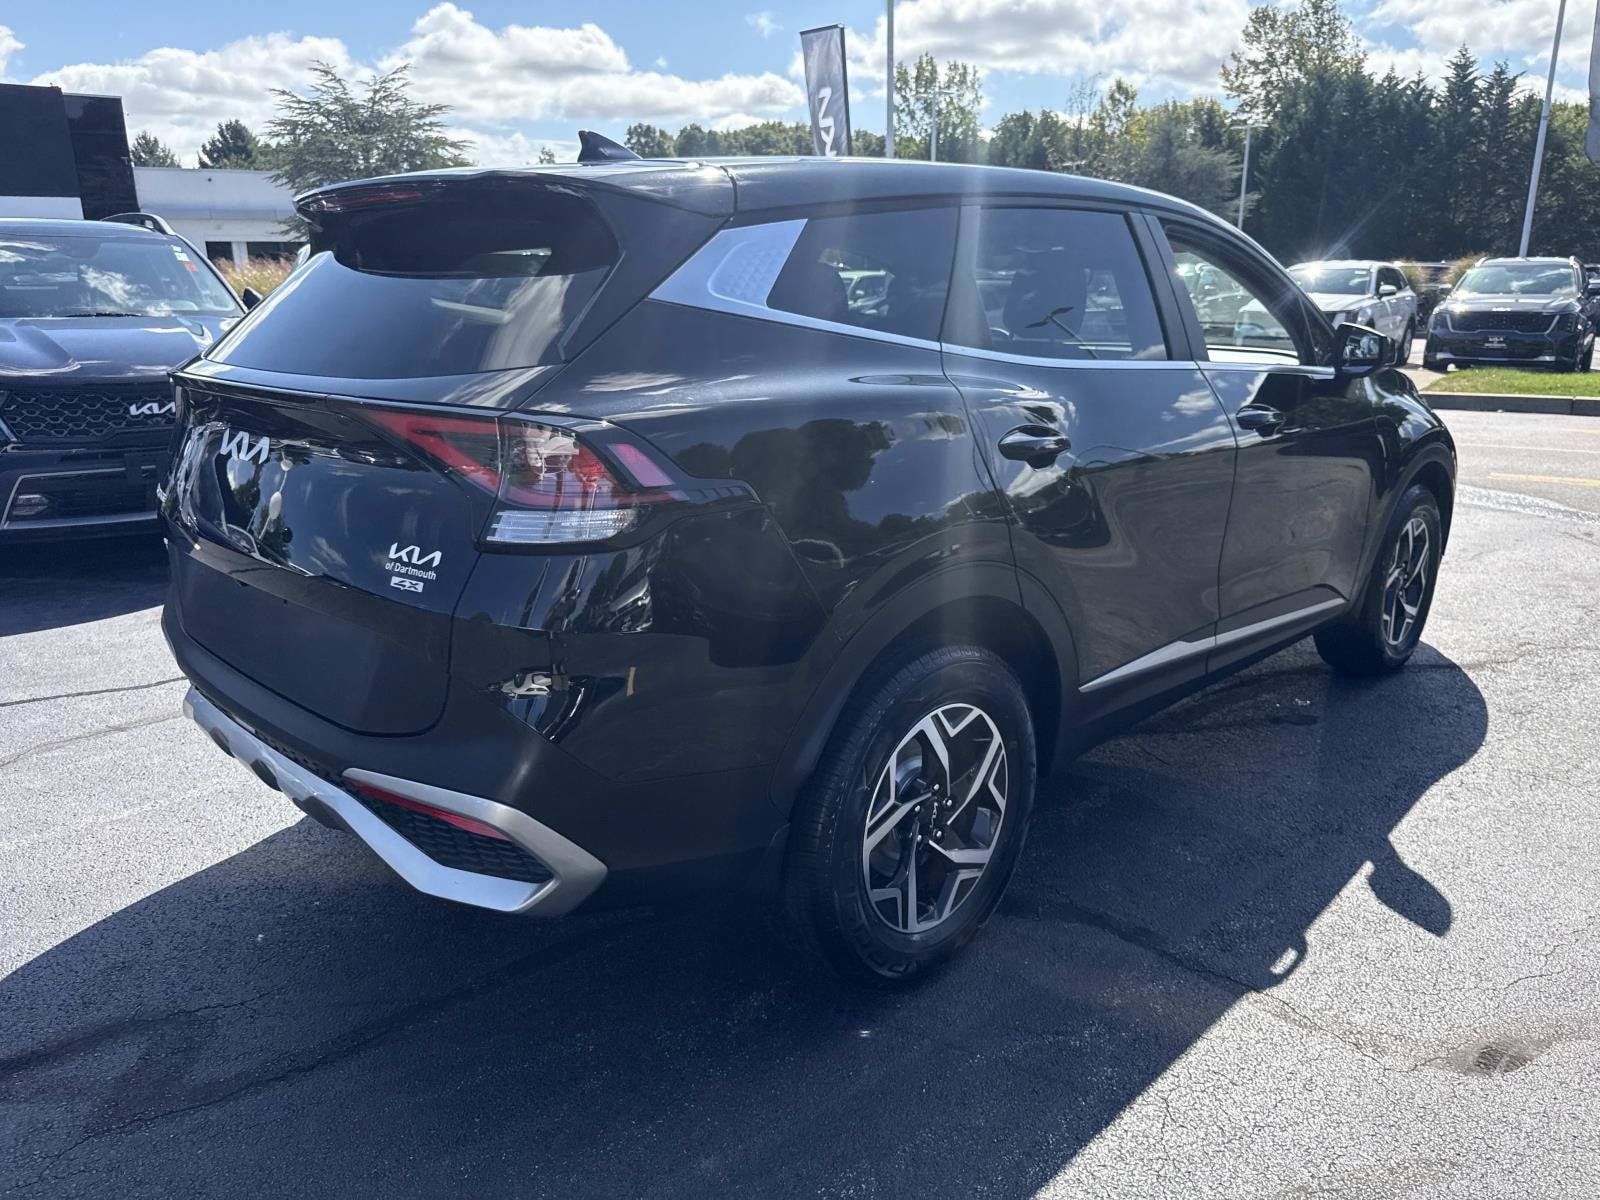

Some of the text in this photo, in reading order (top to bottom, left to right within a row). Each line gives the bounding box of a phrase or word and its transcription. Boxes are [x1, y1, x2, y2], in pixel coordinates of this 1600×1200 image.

[130, 401, 176, 416] KIA
[220, 428, 270, 465] KIA
[388, 542, 442, 568] KIA
[385, 562, 437, 581] of Dartmouth
